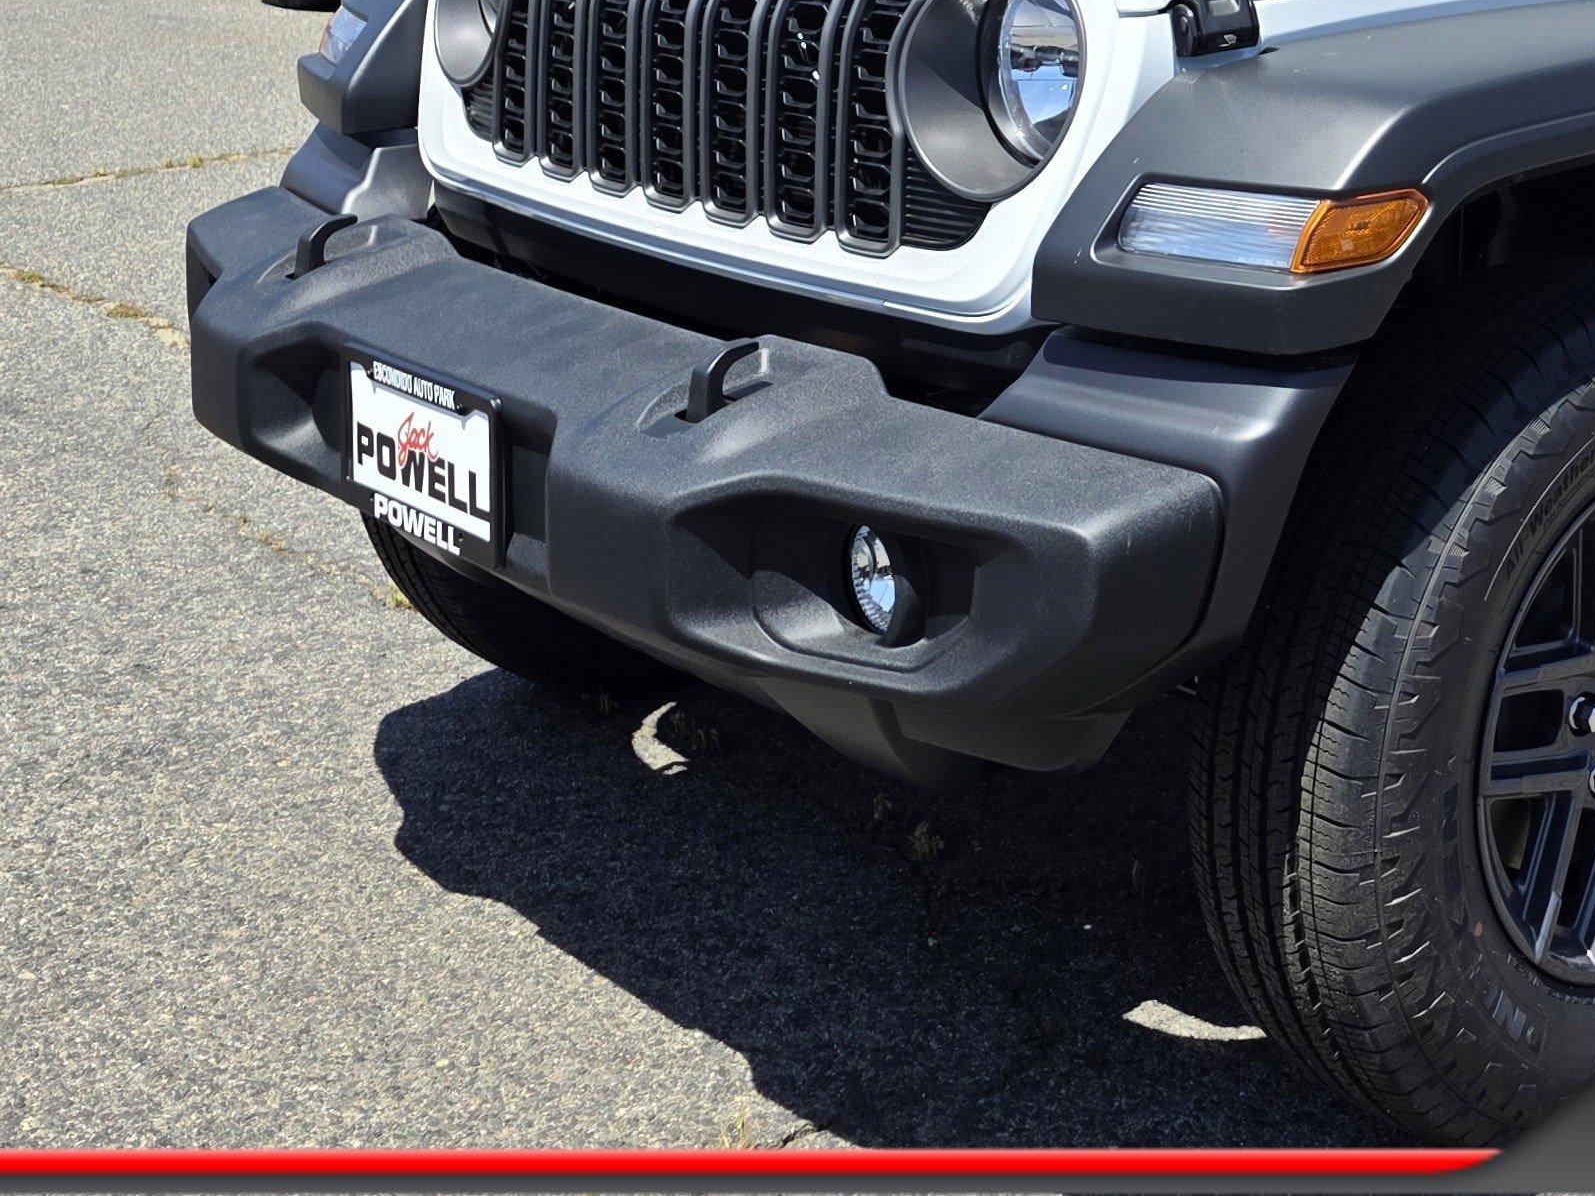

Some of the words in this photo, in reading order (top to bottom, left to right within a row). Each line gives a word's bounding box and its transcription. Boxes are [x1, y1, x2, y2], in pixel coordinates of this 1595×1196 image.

[373, 360, 412, 394] ESCONDIDO
[413, 376, 434, 402] AUTO
[434, 383, 456, 411] PARK
[397, 411, 439, 467] Jack
[357, 421, 491, 518] POWELL
[374, 492, 461, 556] POWELL
